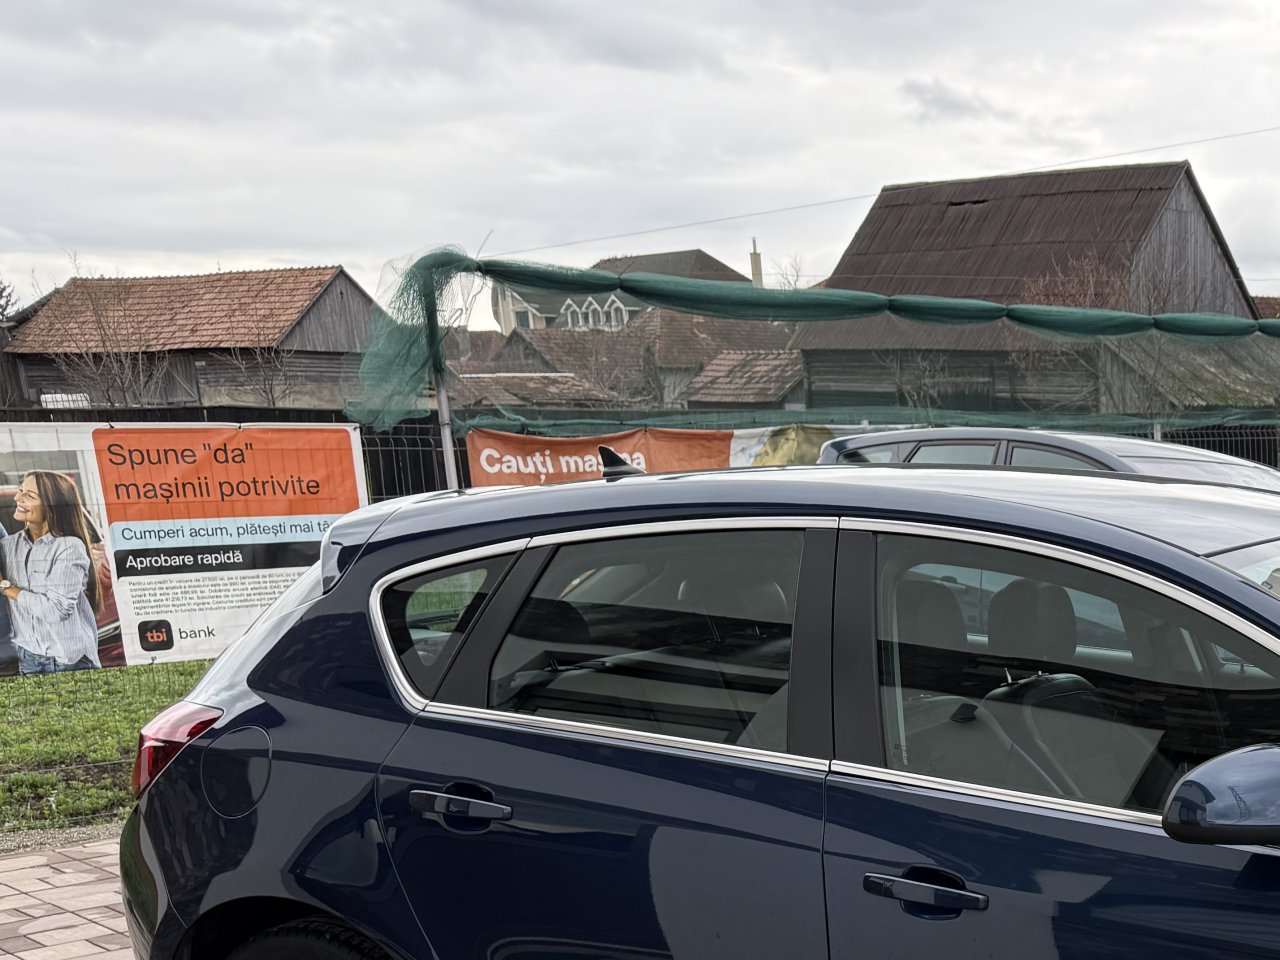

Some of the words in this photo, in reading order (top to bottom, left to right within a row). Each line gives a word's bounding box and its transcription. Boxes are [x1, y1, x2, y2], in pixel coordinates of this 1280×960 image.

[107, 443, 197, 470] Spune
[202, 442, 254, 465] "da"
[479, 447, 554, 483] Cauți
[114, 476, 211, 504] mașinii
[218, 475, 320, 502] potrivite
[121, 524, 185, 542] Cumperi
[189, 525, 233, 538] acum,
[236, 521, 287, 539] plătești
[289, 520, 314, 534] mai
[126, 554, 194, 570] Aprobare
[197, 549, 243, 566] rapidă
[145, 630, 167, 642] tbi
[178, 626, 216, 640] bank
